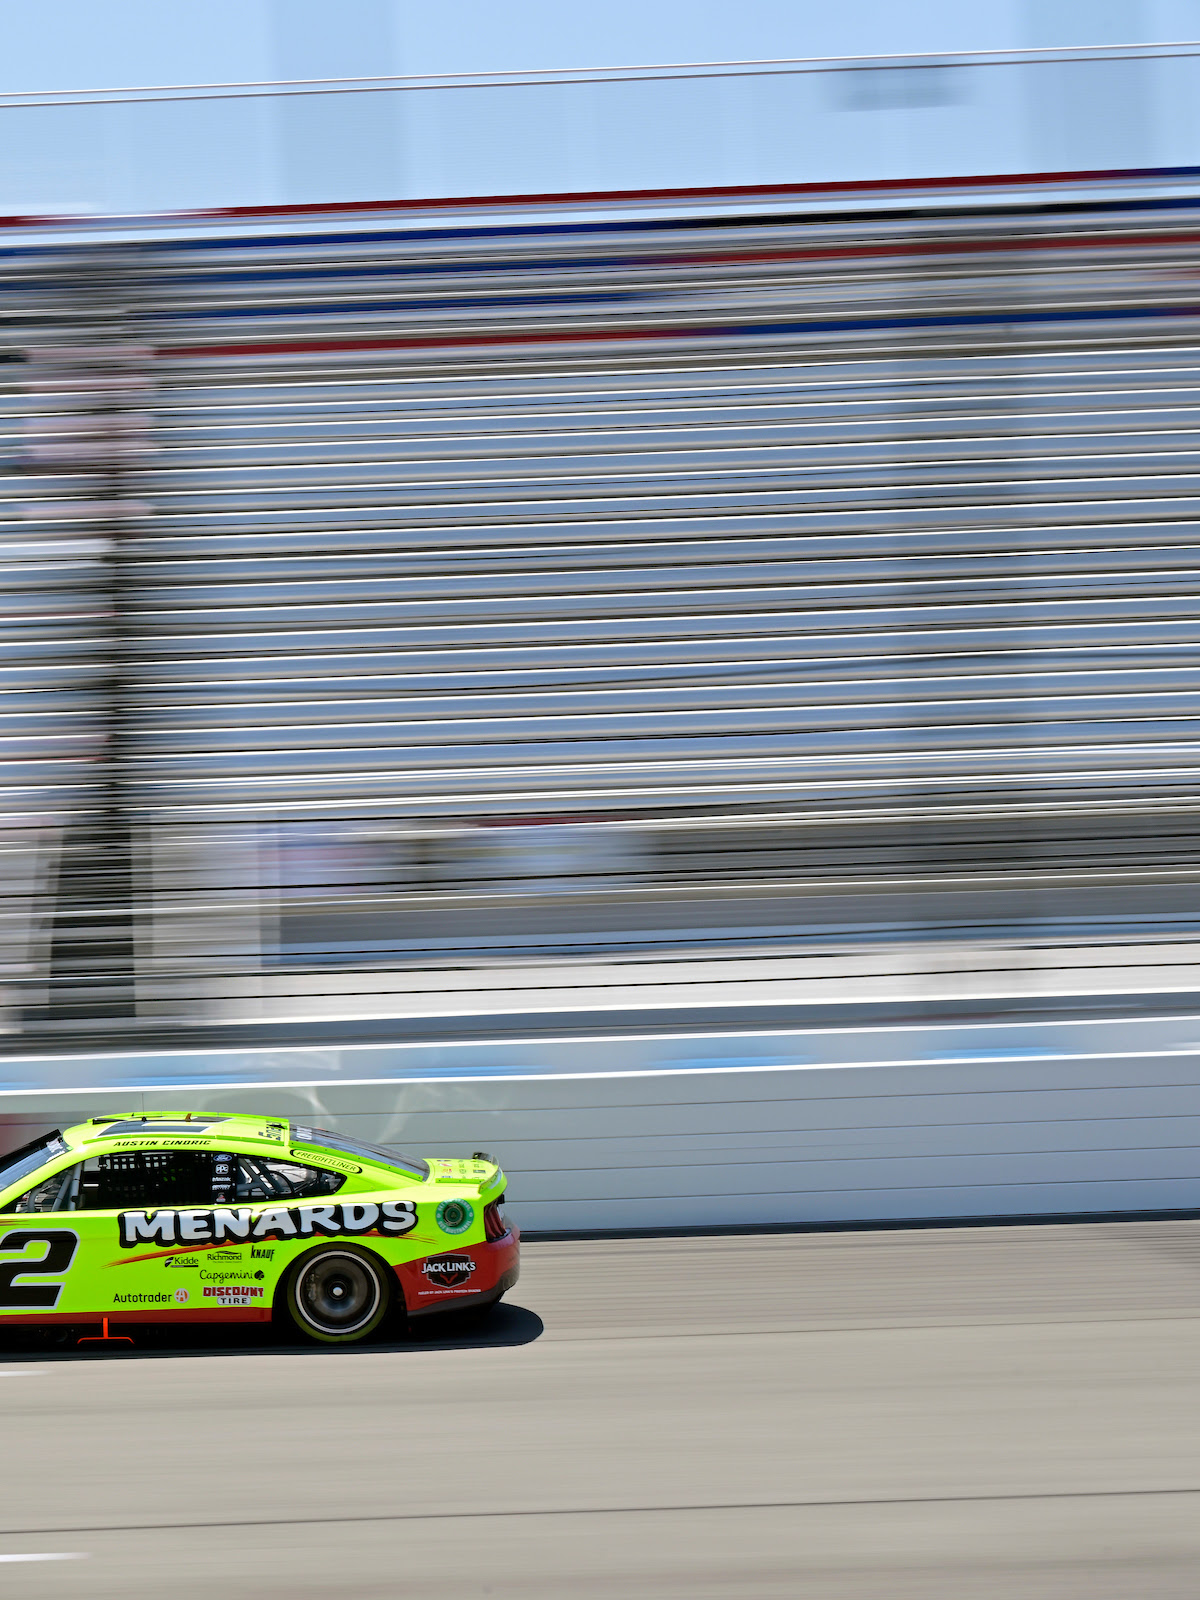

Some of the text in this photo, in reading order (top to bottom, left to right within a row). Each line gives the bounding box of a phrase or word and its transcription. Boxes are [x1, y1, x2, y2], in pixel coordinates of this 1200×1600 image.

[296, 1150, 357, 1171] FREIGHTLINER
[216, 1164, 229, 1173] PPG
[120, 1200, 417, 1245] MENARDS
[207, 1252, 242, 1261] Richmond
[250, 1246, 275, 1262] KNAUF
[174, 1257, 199, 1265] Kidde
[421, 1261, 477, 1274] JACK LINK'S
[199, 1269, 253, 1284] Capgemini
[113, 1292, 172, 1303] Autotrader
[202, 1286, 264, 1298] DISCOUNT
